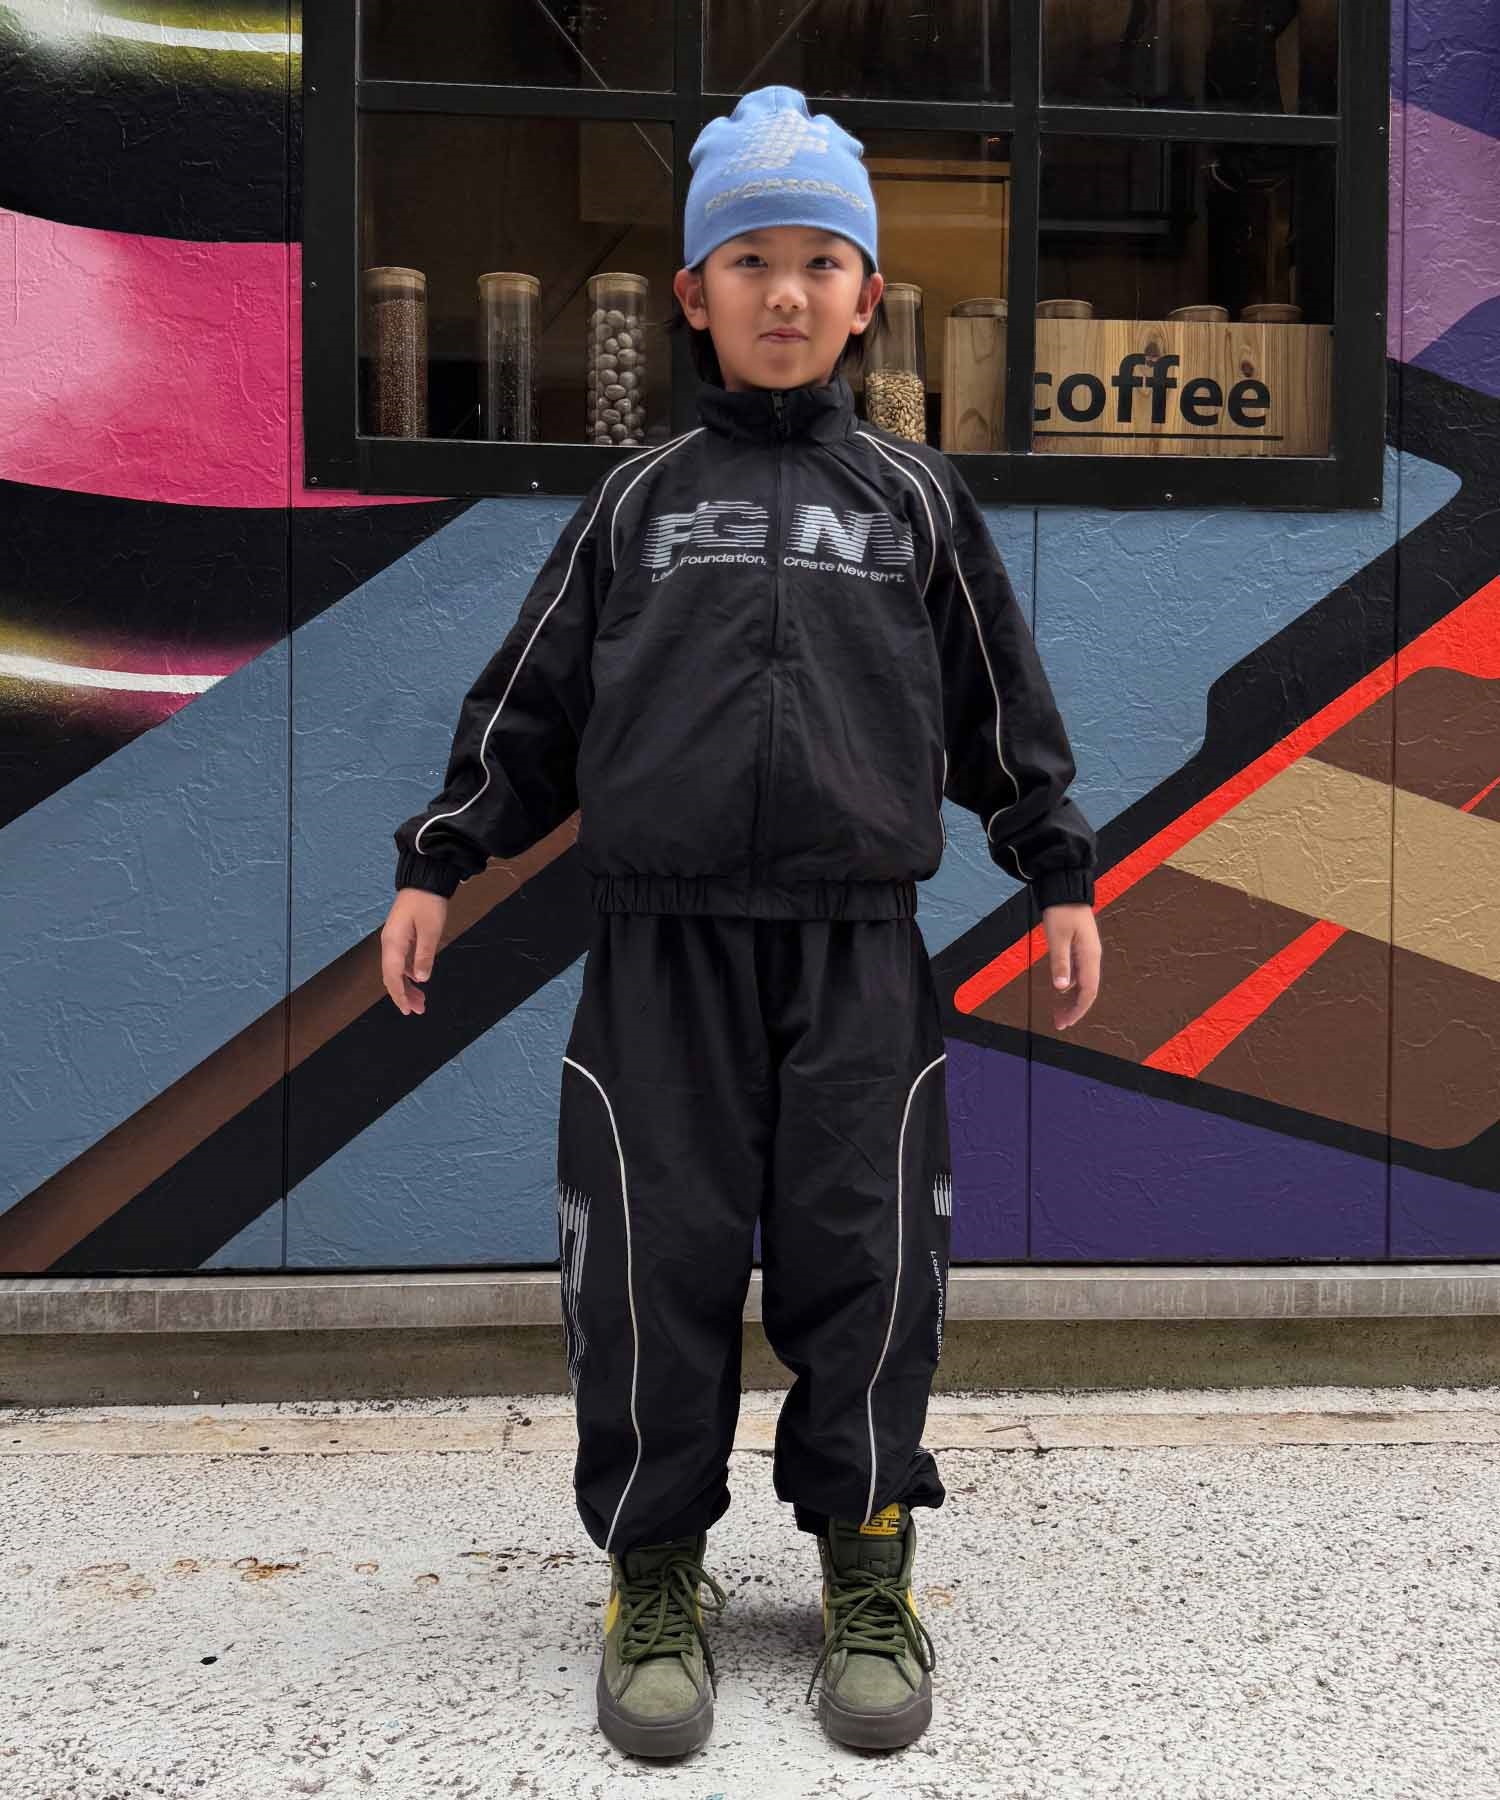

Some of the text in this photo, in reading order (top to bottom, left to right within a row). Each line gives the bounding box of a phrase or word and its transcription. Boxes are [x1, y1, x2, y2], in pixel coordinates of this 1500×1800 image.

[680, 553, 767, 565] Foundation,
[783, 556, 836, 572] Create
[837, 562, 868, 579] New
